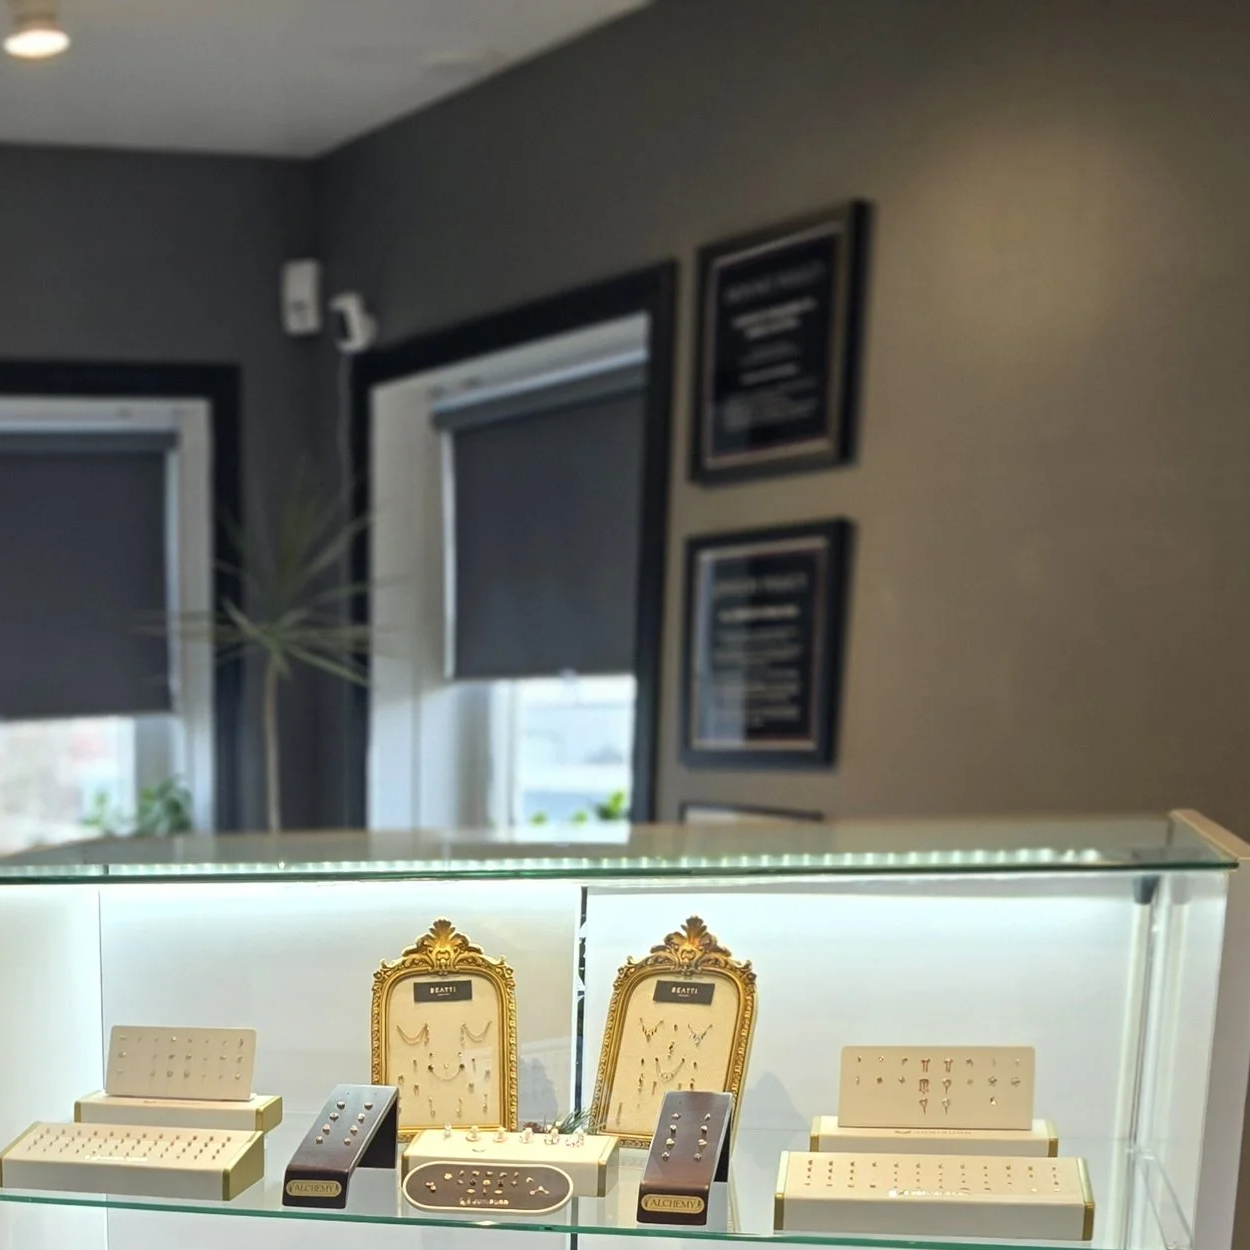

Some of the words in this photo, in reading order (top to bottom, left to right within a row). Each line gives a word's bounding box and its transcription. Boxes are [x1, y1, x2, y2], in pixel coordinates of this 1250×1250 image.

[430, 986, 456, 994] BEATTI
[671, 986, 698, 994] BEATTI
[294, 1183, 334, 1193] ALCHEMY
[650, 1199, 696, 1210] ALCHEMY
